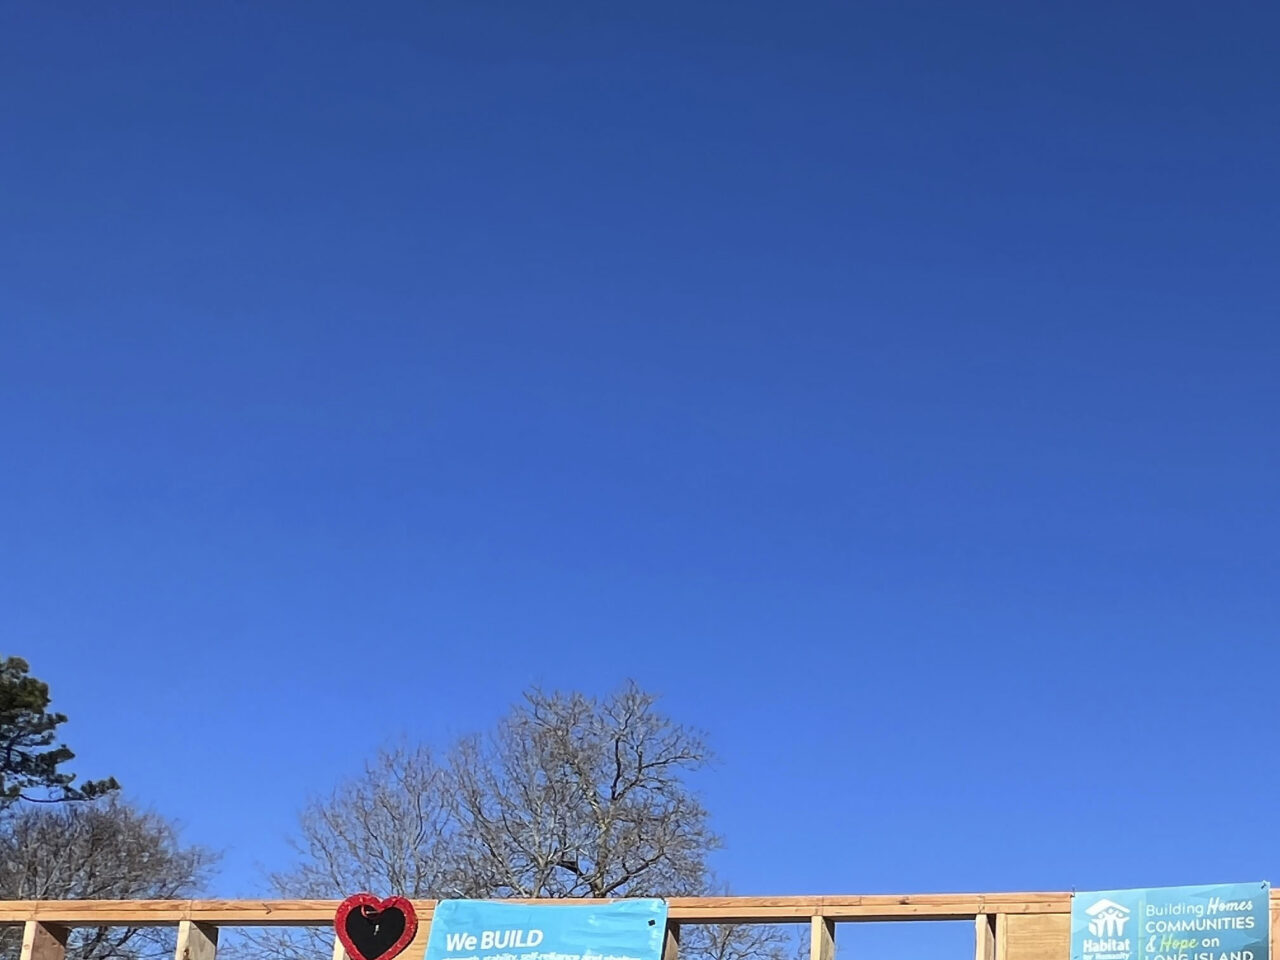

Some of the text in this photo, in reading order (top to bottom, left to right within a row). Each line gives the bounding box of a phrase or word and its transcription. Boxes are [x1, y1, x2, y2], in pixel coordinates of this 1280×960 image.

[1146, 897, 1253, 917] Building Homes
[1145, 917, 1255, 933] COMMUNITIES
[445, 929, 543, 952] We BUILD
[1083, 938, 1130, 952] Habitat
[1145, 933, 1220, 954] & Hope on
